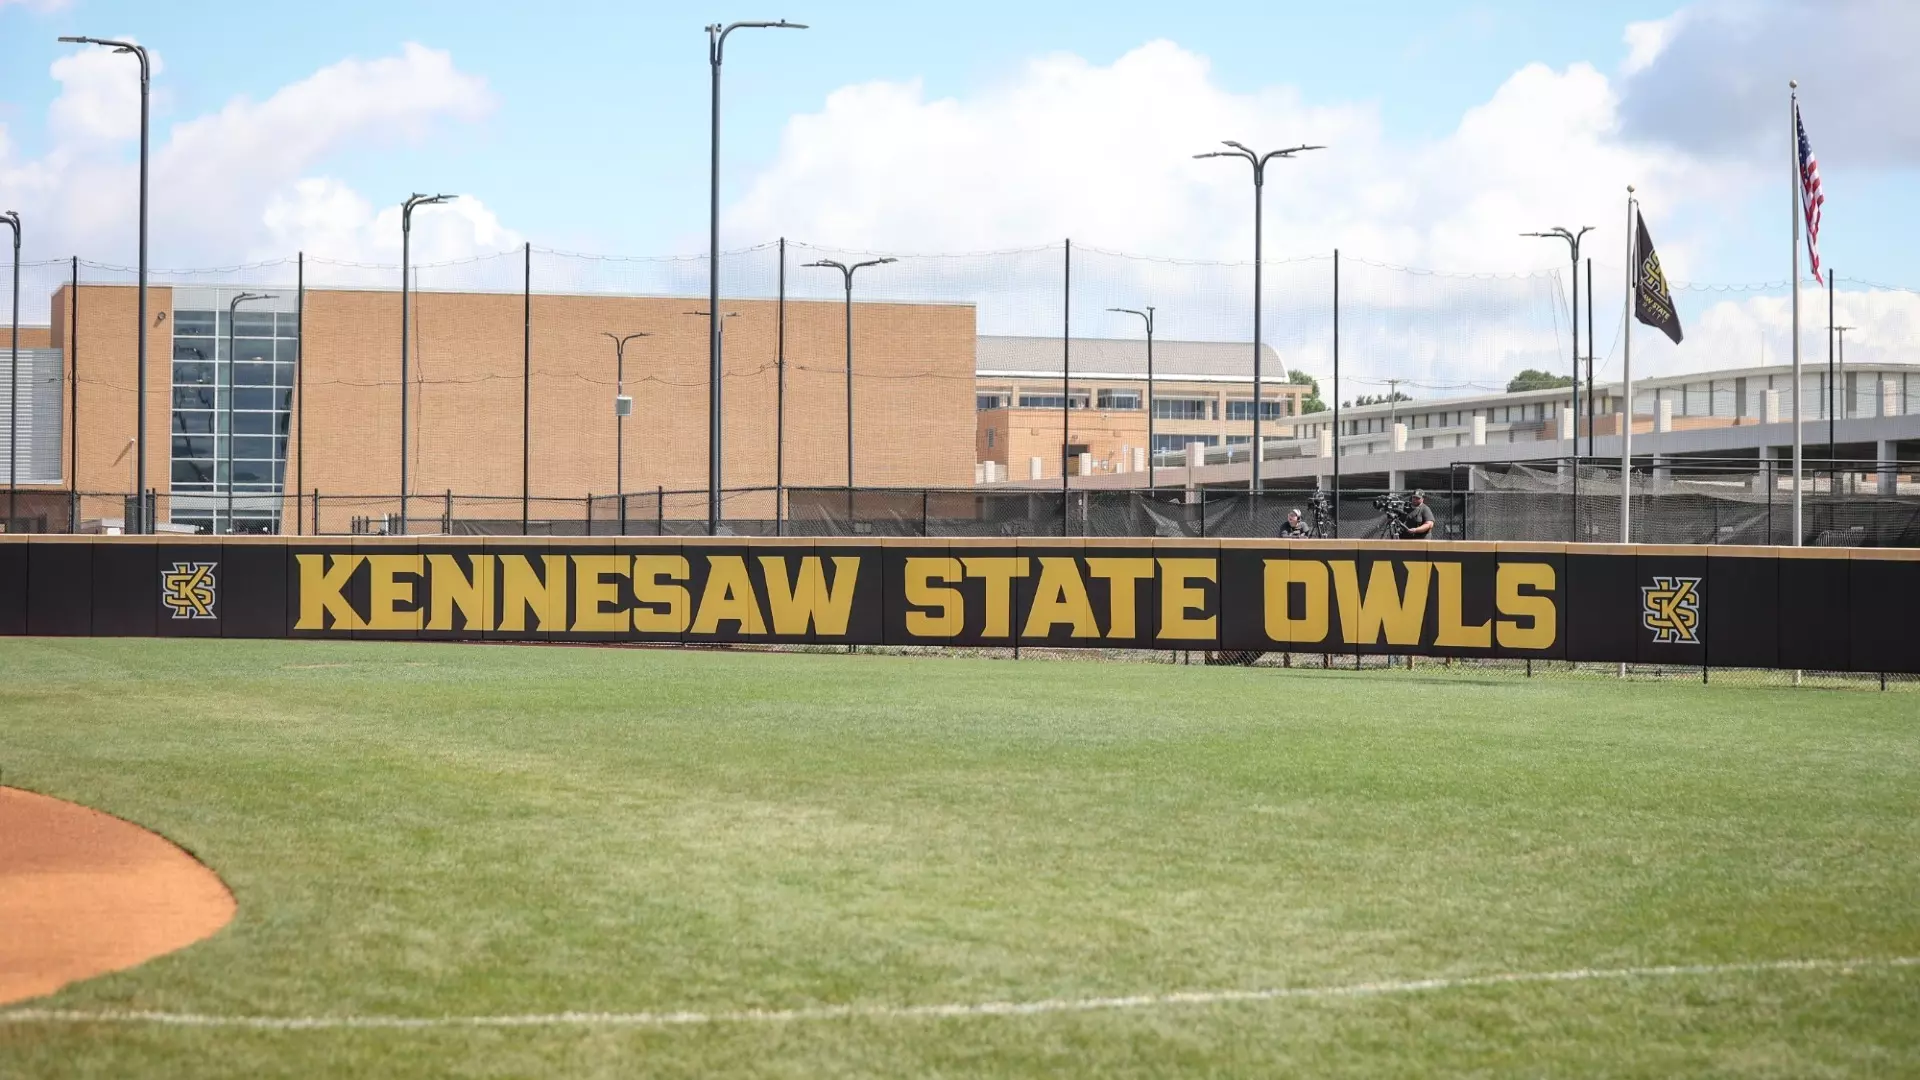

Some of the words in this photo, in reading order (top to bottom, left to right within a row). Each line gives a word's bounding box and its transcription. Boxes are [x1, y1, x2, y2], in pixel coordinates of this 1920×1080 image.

[1652, 302, 1670, 319] STATE
[294, 554, 860, 635] KENNESAW
[904, 557, 1217, 640] STATE
[1263, 559, 1556, 649] OWLS
